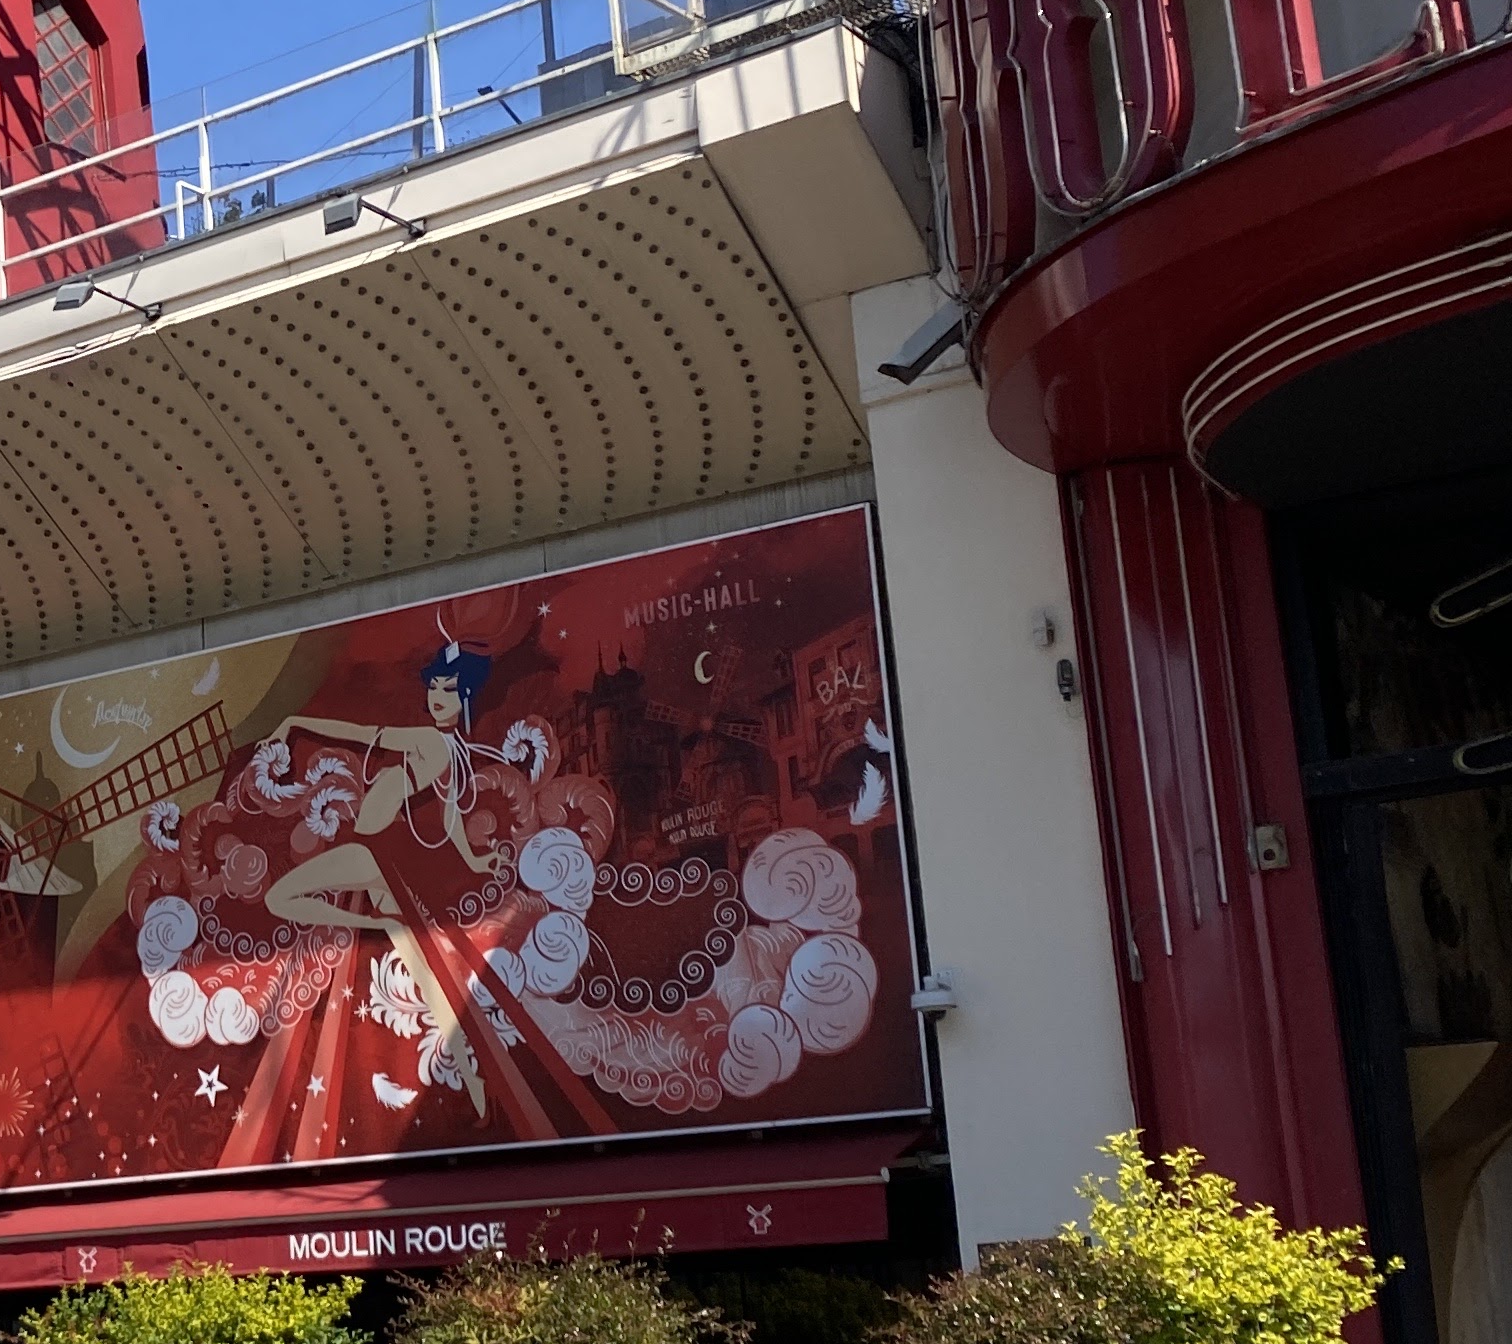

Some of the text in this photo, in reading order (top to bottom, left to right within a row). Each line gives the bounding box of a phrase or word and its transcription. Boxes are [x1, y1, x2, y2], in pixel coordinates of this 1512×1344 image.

[624, 579, 761, 629] MUSIC-HALL
[816, 661, 866, 705] BAL
[289, 1222, 508, 1260] MOULIN ROUGE
